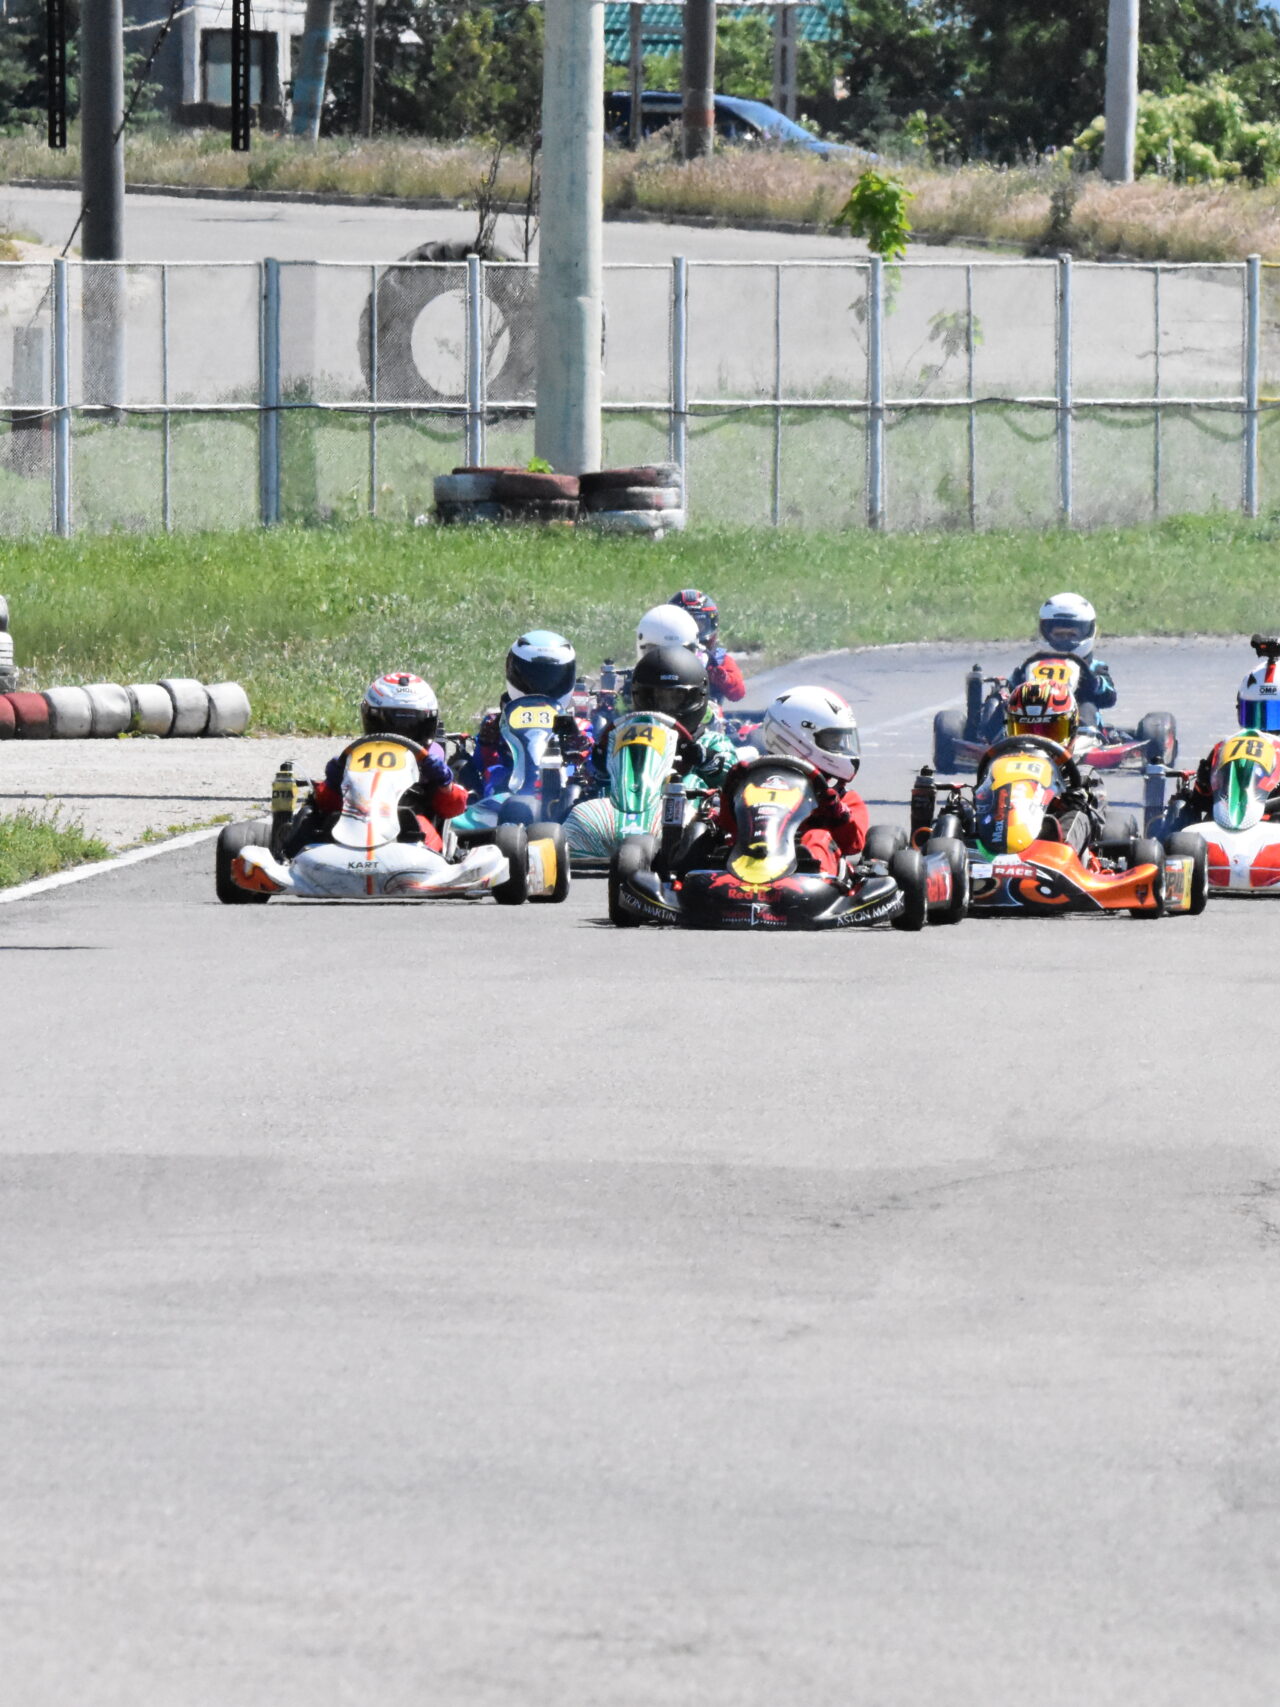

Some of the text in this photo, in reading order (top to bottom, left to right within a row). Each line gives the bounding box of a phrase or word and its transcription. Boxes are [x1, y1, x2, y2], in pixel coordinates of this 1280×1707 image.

[1038, 667, 1065, 680] 91
[521, 711, 550, 724] 33
[622, 727, 653, 742] 44
[1228, 739, 1264, 758] 78
[357, 751, 398, 769] 10
[1014, 762, 1042, 773] 16
[767, 791, 777, 801] 1
[992, 820, 1004, 842] Max
[347, 861, 379, 870] KART
[995, 867, 1034, 876] RACE
[727, 888, 782, 902] Red Bull
[643, 903, 677, 921] MARTIN
[836, 909, 871, 927] ASTON
